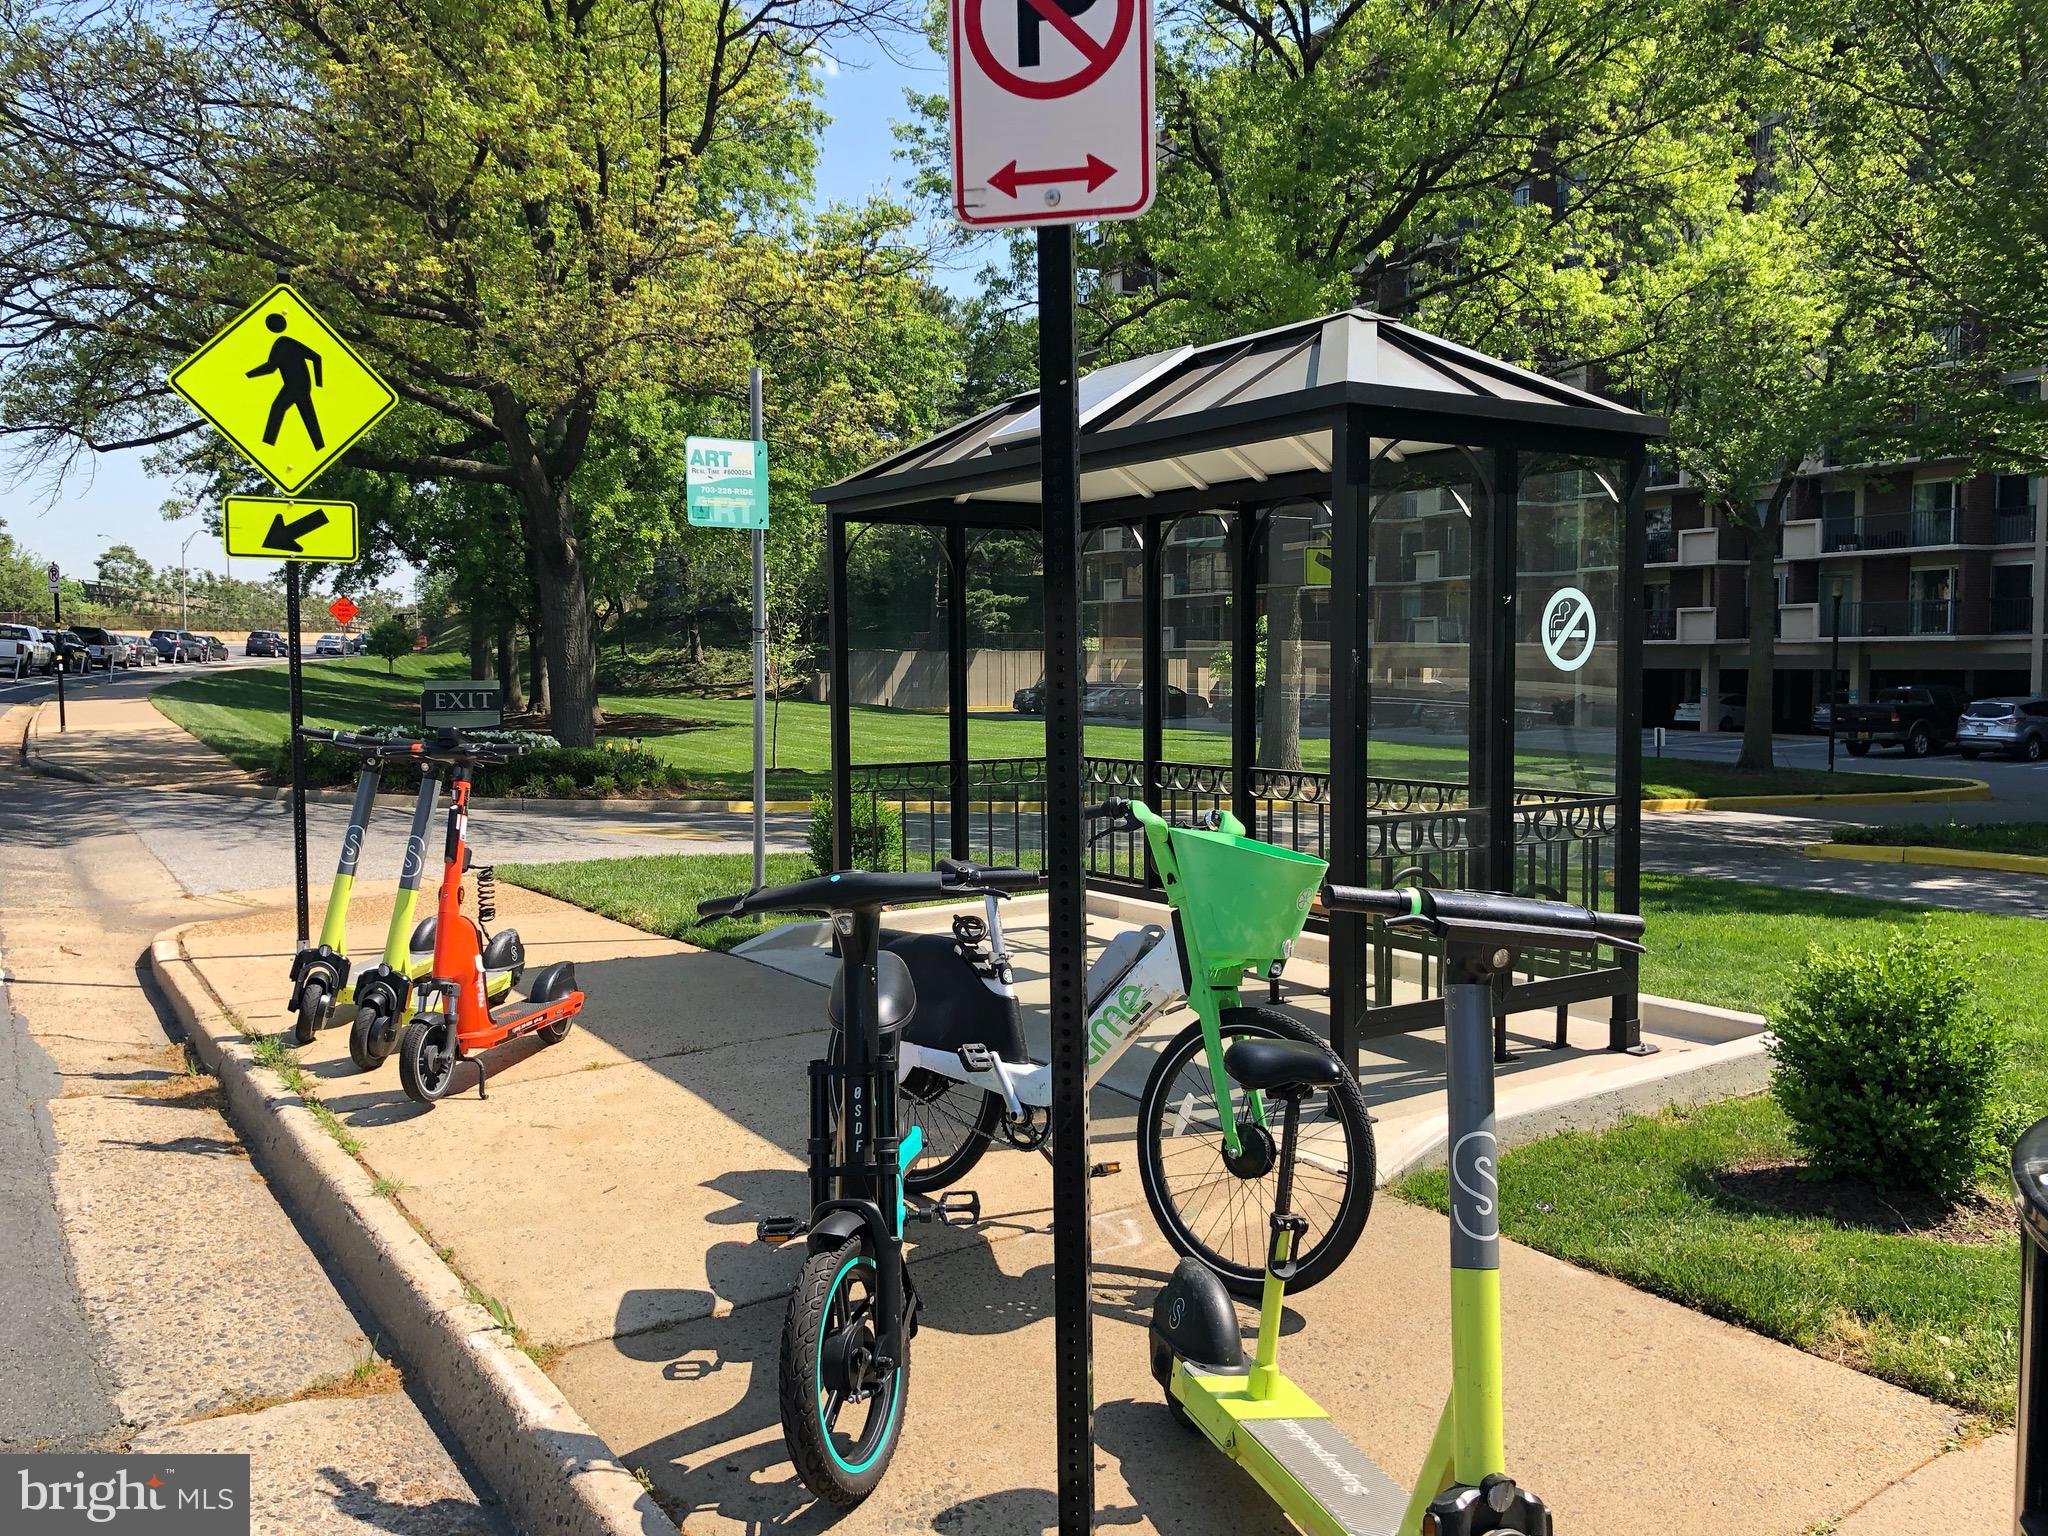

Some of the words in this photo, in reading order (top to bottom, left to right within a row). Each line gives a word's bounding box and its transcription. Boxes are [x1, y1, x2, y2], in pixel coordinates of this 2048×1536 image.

[690, 449, 732, 467] ART
[701, 486, 753, 496] 703-228-RIDE
[433, 692, 493, 709] EXIT
